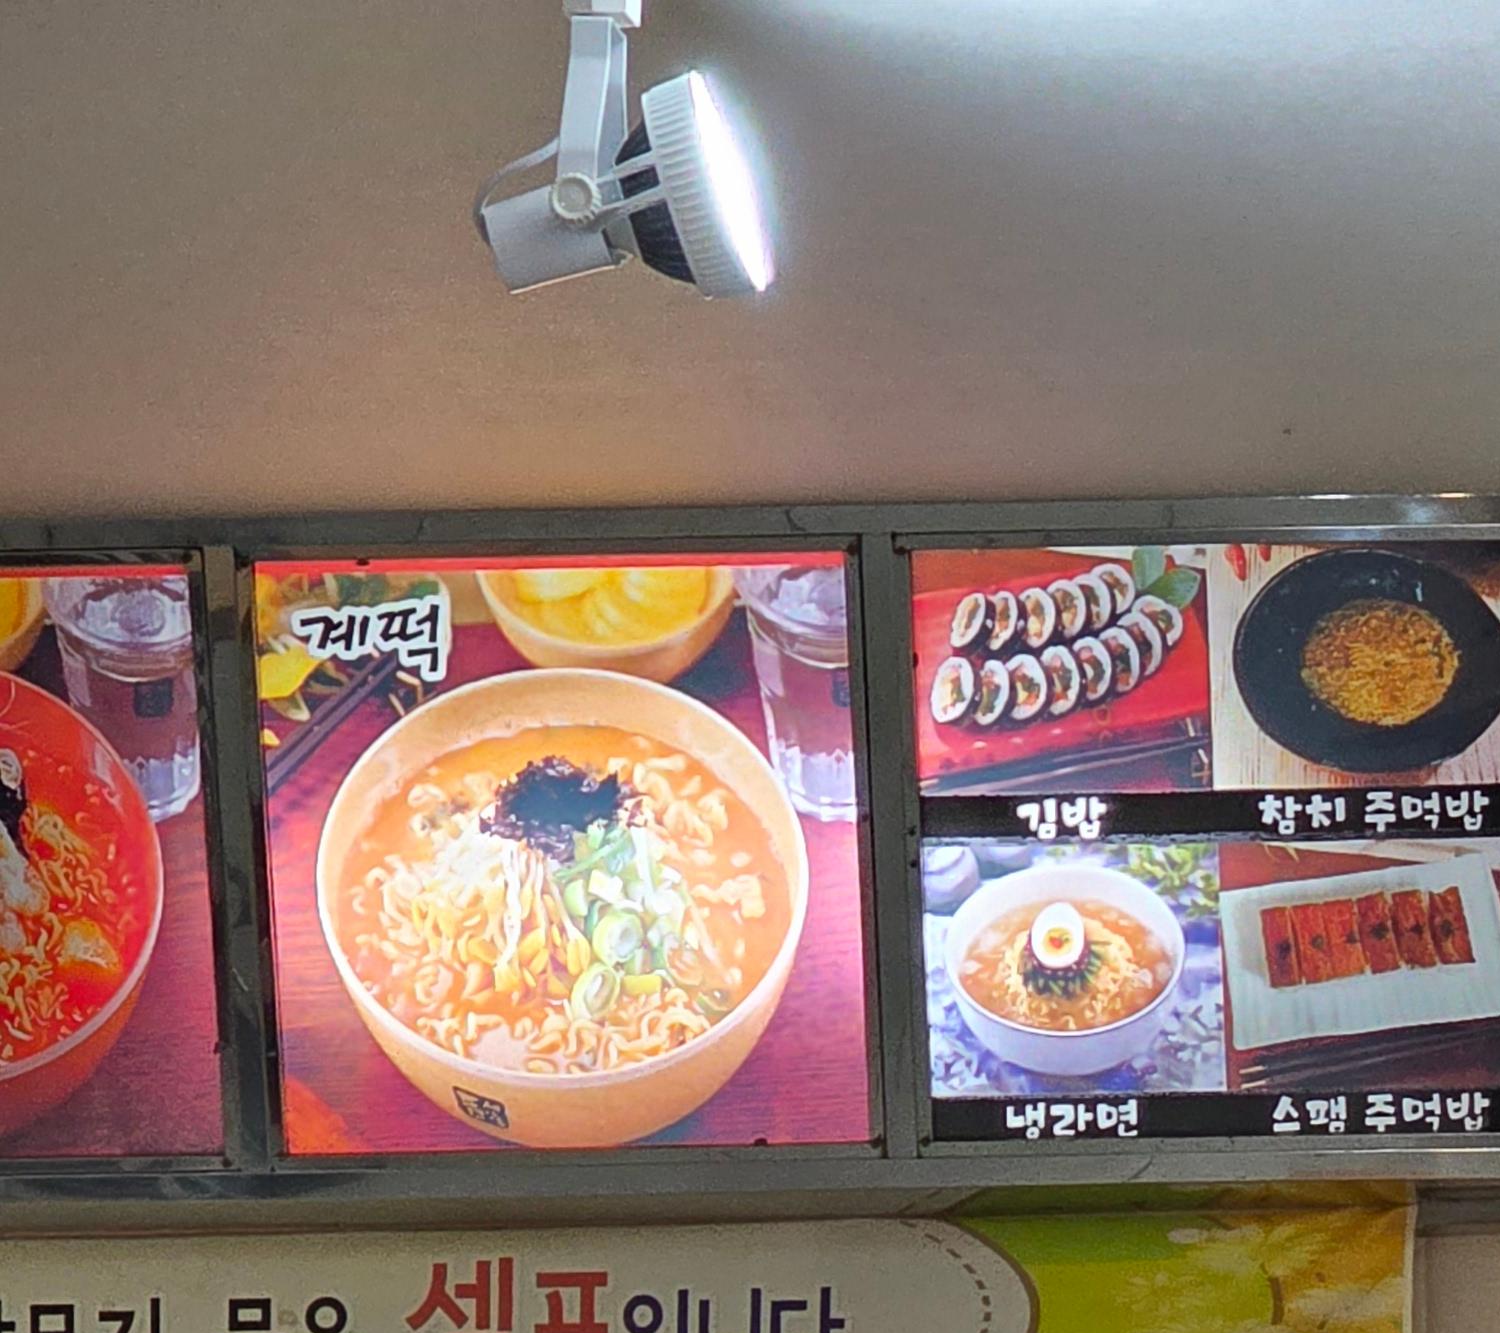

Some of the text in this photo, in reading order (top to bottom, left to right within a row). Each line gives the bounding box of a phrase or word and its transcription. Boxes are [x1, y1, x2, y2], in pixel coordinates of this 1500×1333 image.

[298, 602, 441, 673] 계떡
[1016, 796, 1107, 839] 김밥
[1258, 789, 1490, 836] 참치 주먹밥
[1005, 1098, 1140, 1139] 냉라면
[1272, 1092, 1491, 1134] 스팸 주먹밥
